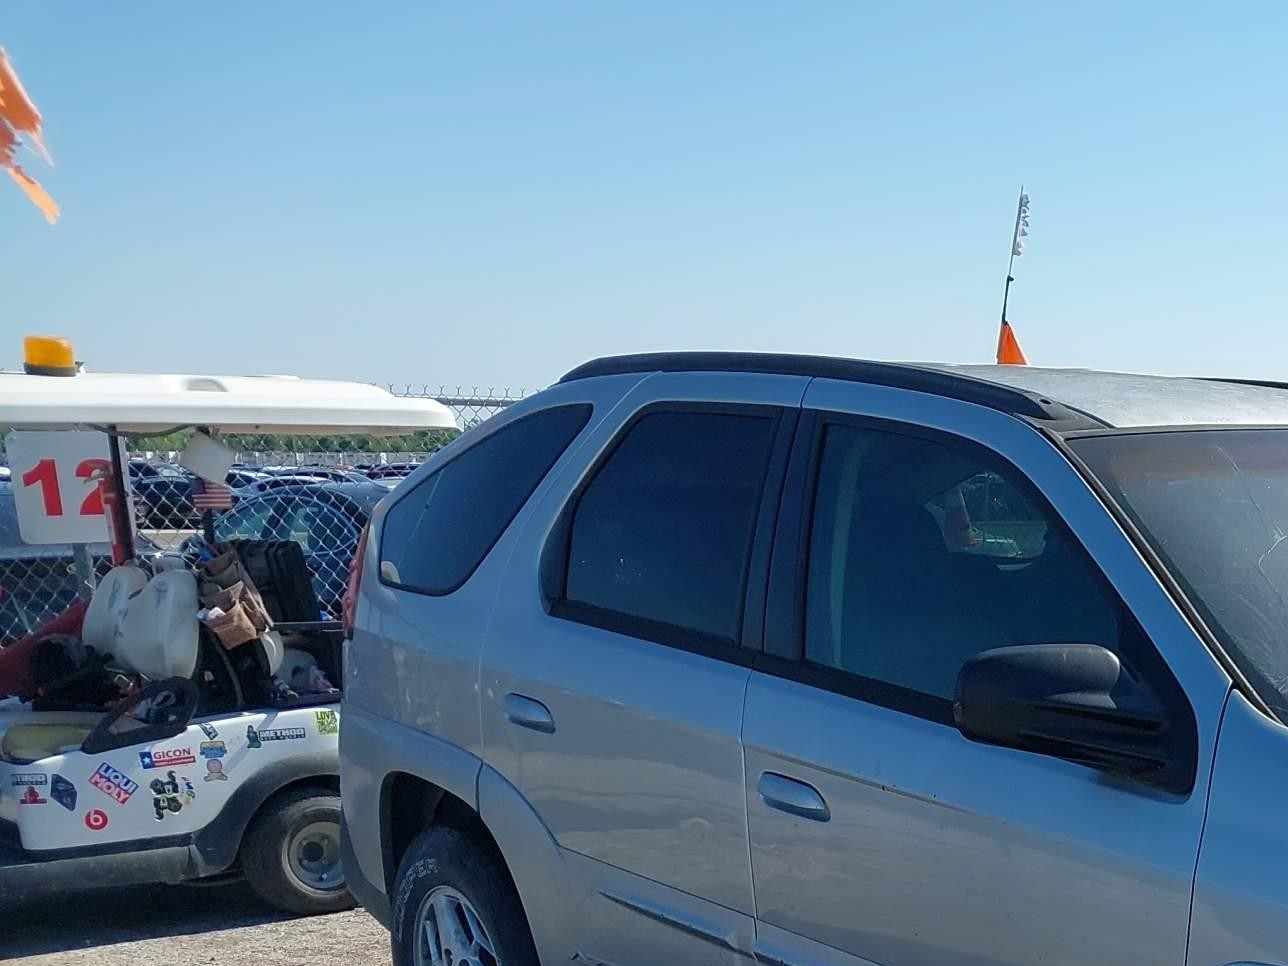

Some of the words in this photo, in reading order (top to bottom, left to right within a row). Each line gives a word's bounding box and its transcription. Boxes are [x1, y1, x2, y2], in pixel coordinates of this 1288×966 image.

[22, 458, 112, 516] 12
[260, 728, 304, 738] METHOD
[153, 748, 191, 760] GICON
[91, 773, 130, 803] MOLY
[99, 763, 138, 793] LIQUI
